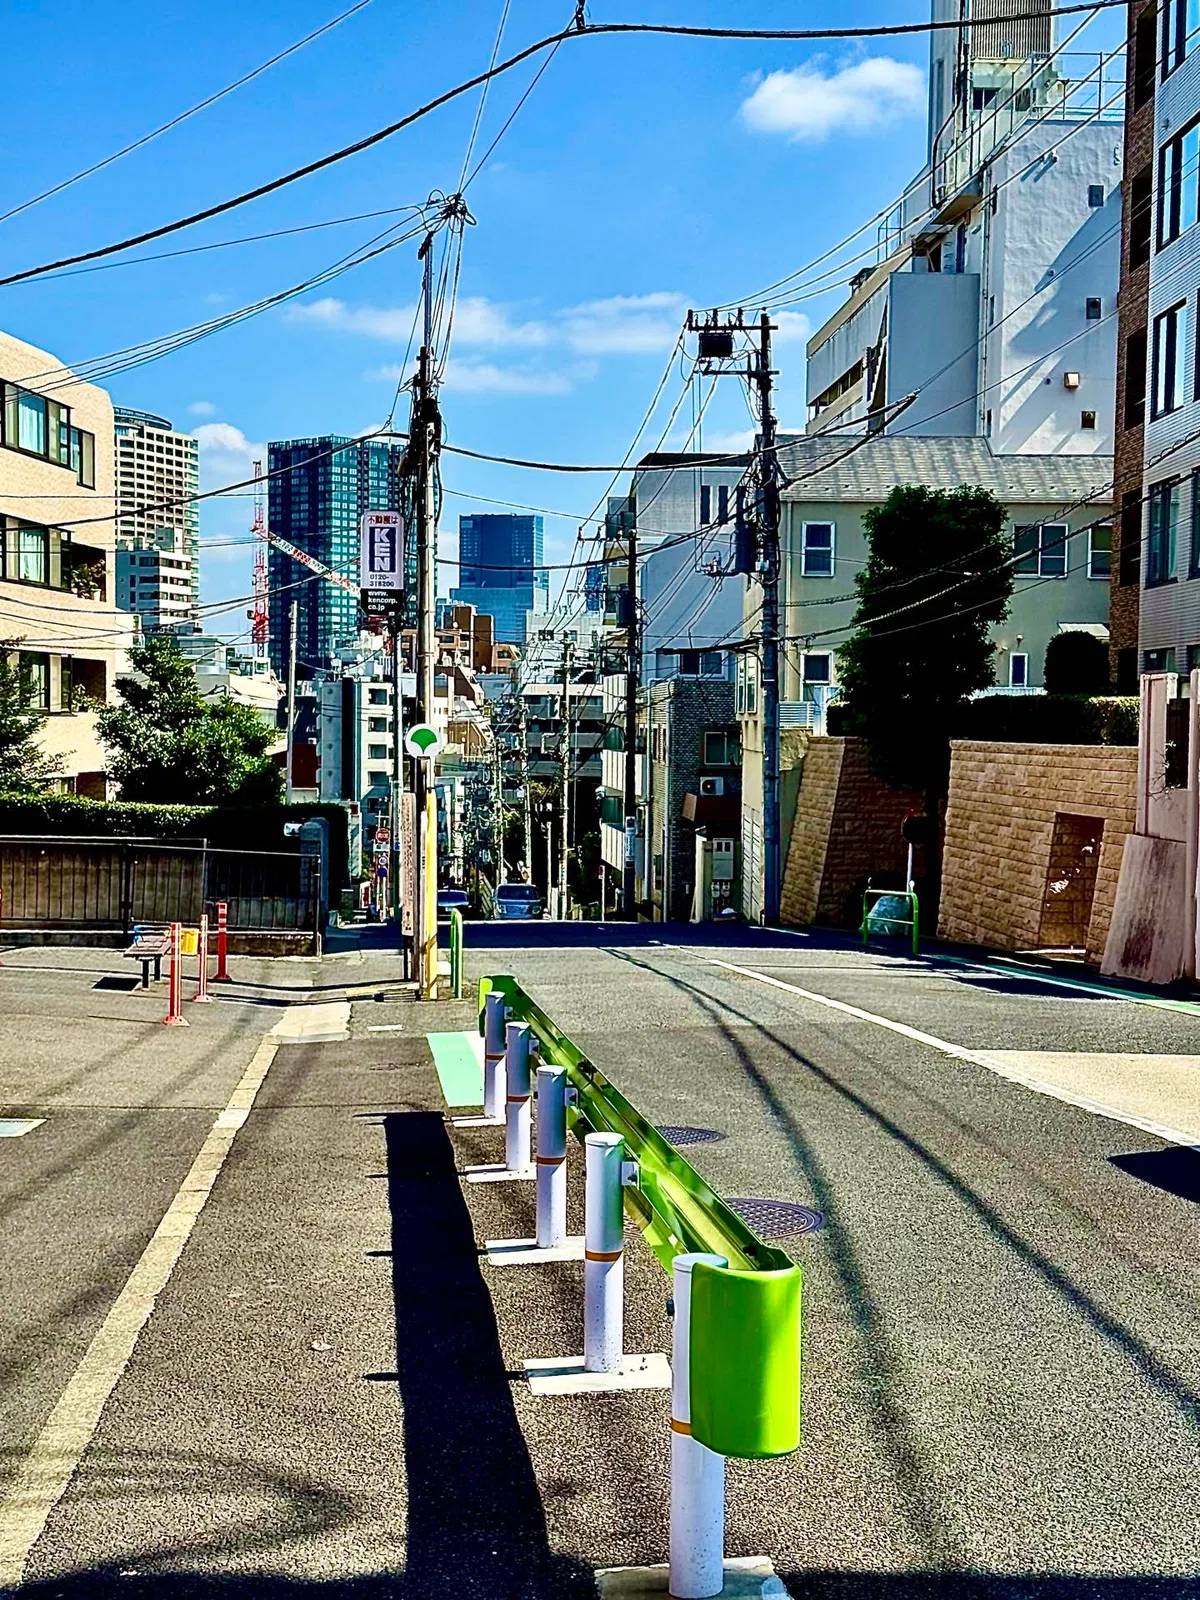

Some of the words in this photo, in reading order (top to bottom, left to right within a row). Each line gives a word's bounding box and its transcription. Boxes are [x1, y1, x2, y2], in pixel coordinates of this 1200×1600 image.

[368, 516, 398, 524] 不動産は
[374, 528, 390, 571] KEN
